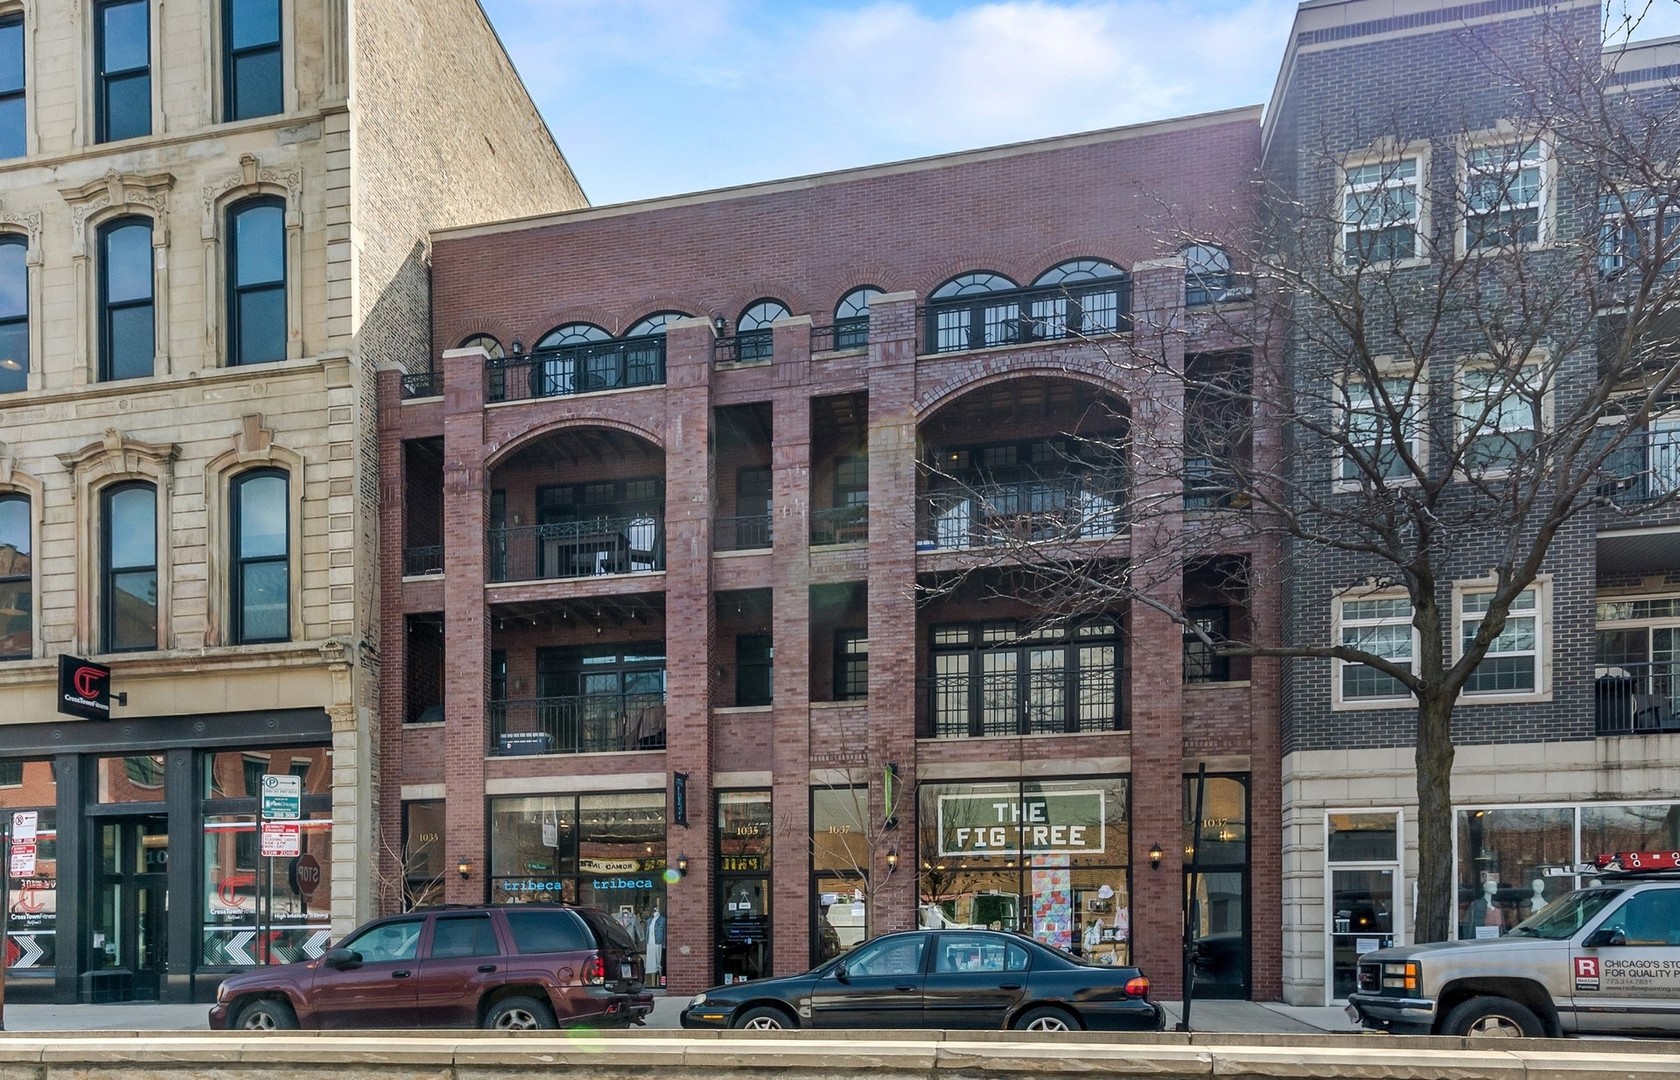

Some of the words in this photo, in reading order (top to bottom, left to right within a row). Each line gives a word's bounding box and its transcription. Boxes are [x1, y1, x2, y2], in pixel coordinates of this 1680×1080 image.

[992, 802, 1046, 823] THE
[1203, 818, 1228, 828] 1037
[736, 826, 759, 836] 1035
[829, 825, 851, 834] 1037
[419, 833, 439, 842] 1035
[956, 827, 1006, 847] FIG
[1014, 825, 1087, 846] TREE
[503, 880, 563, 891] tribeca
[592, 878, 653, 890] tribeca
[1578, 959, 1596, 976] R
[1604, 959, 1660, 968] CHICAGO'S
[1605, 969, 1626, 977] FOR
[1628, 969, 1671, 978] QUALITY
